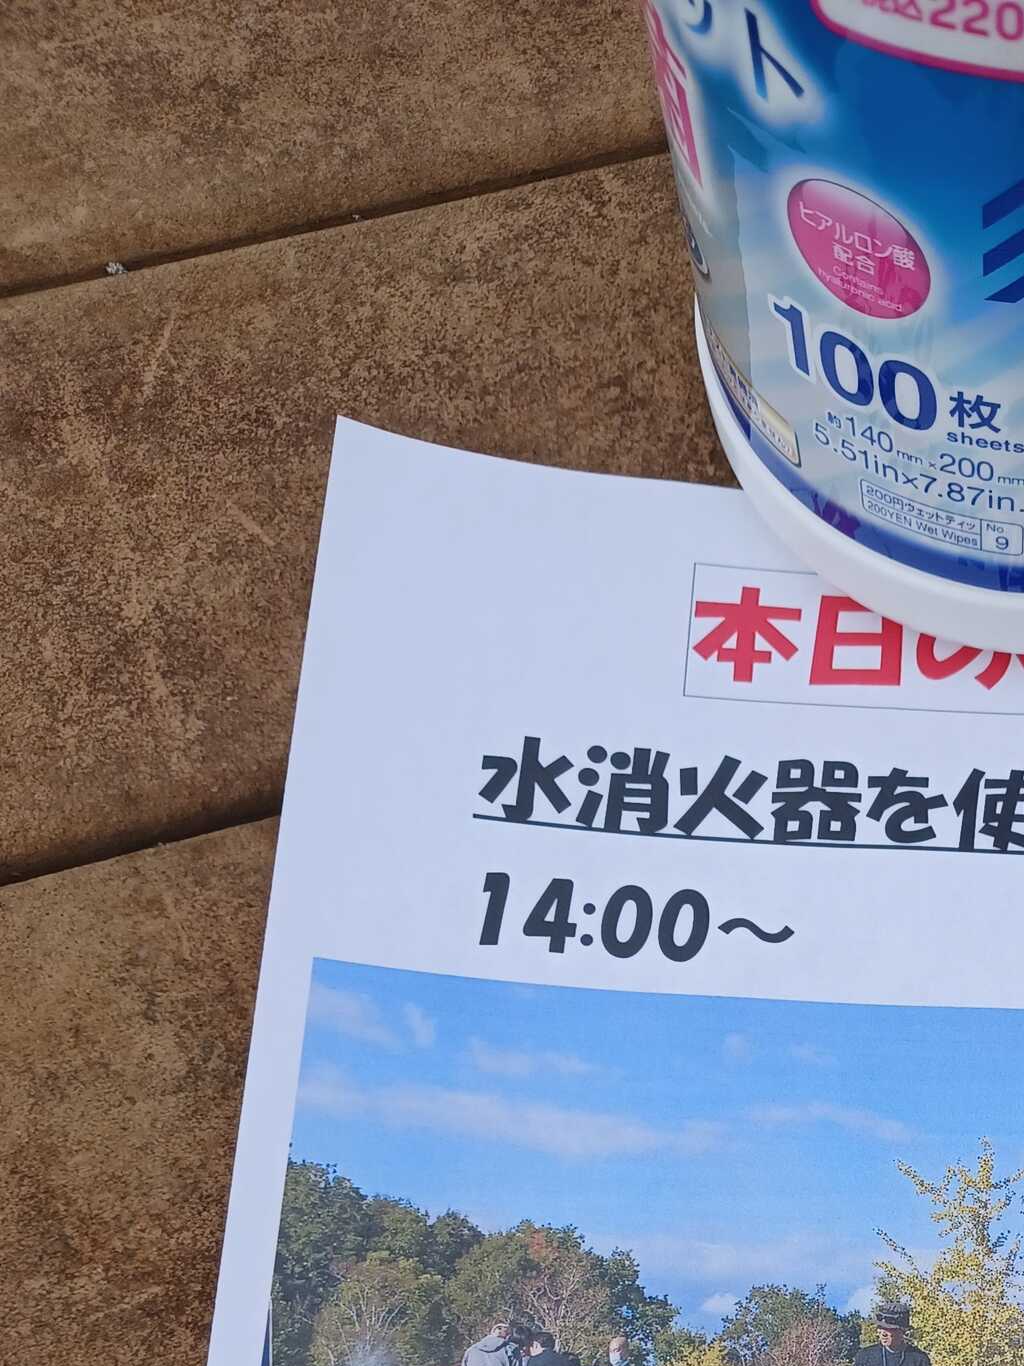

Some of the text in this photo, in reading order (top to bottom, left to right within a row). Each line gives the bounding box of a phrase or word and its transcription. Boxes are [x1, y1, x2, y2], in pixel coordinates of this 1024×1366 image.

[800, 201, 915, 271] ヒアルロン酸
[832, 241, 874, 275] 配合
[947, 431, 1024, 453] sheets
[867, 500, 978, 546] 200YEN Wet Wipes
[996, 536, 1009, 550] 9
